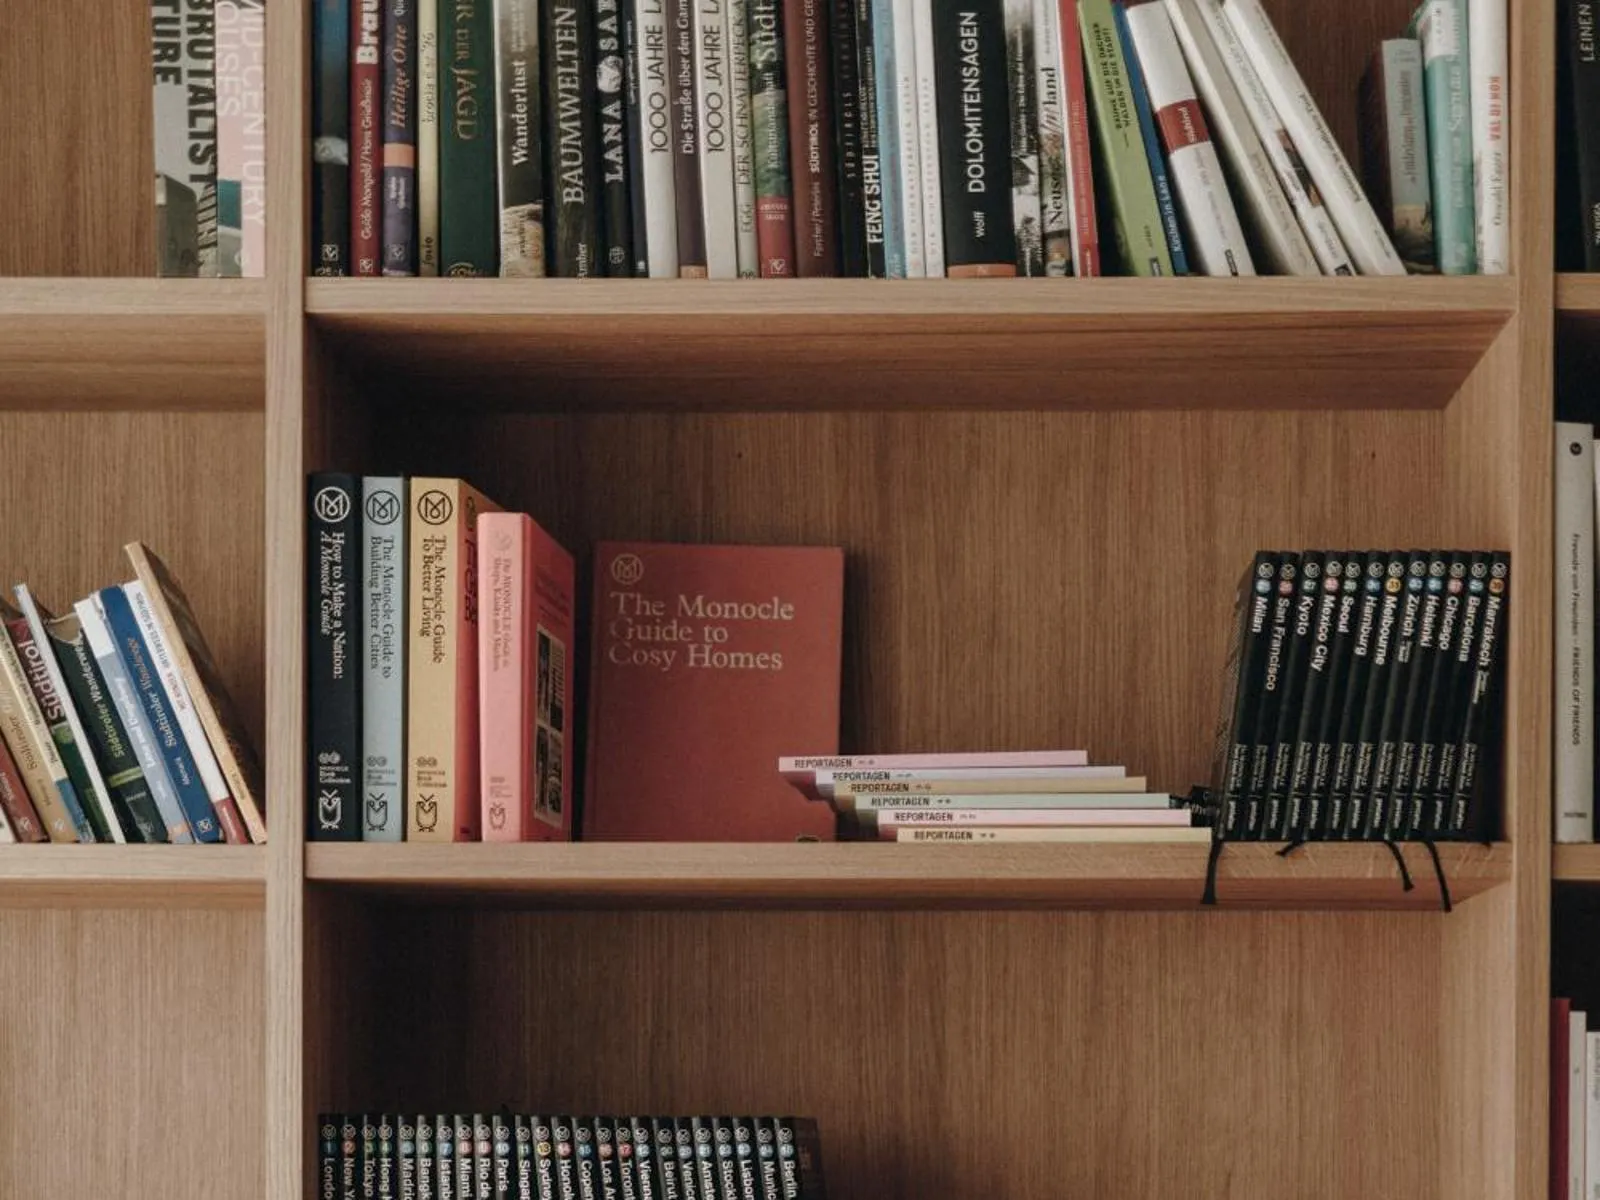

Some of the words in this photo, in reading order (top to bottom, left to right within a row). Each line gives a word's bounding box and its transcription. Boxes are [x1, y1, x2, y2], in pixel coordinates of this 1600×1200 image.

[676, 31, 690, 55] den
[1577, 3, 1595, 62] LEINEN
[646, 25, 666, 87] JAHRE
[676, 57, 692, 85] über
[703, 25, 723, 87] JAHRE
[390, 69, 410, 128] Heilige
[451, 66, 479, 140] JAGD
[511, 59, 528, 167] Wanderlust
[554, 6, 585, 205] BAUMWELTEN
[678, 87, 694, 130] Straße
[960, 12, 985, 193] DOLOMITENSAGEN
[602, 100, 624, 183] LANA
[648, 92, 669, 153] 1000
[706, 92, 726, 153] 1000
[682, 133, 695, 154] Die
[863, 154, 881, 197] SHUI
[865, 200, 883, 243] FENG
[332, 531, 345, 561] How
[369, 536, 382, 588] Building
[382, 536, 394, 561] The
[422, 536, 434, 551] To
[434, 535, 447, 562] The
[333, 564, 345, 578] to
[422, 555, 433, 592] Better
[332, 582, 346, 617] Make
[370, 592, 381, 629] Better
[382, 565, 394, 620] Monocle
[434, 566, 446, 620] Monocle
[610, 592, 665, 616] The
[677, 594, 795, 620] Monocle
[1278, 598, 1290, 624] San
[420, 596, 434, 638] Living
[610, 617, 693, 641] Guide
[703, 625, 729, 644] to
[1252, 596, 1268, 633] Milan
[1296, 596, 1313, 635] Kyoto
[1317, 595, 1336, 642] Mexico
[1337, 596, 1354, 633] Seoul
[1354, 596, 1377, 656] Hamburg
[1374, 595, 1398, 665] Melbourne
[1401, 594, 1420, 637] Zürich
[1420, 594, 1439, 647] Helsinki
[1439, 596, 1459, 650] Chicago
[1459, 596, 1480, 661] Barcelona
[1479, 596, 1500, 666] Marrakech
[332, 631, 347, 679] Nation:
[370, 633, 381, 670] Cities
[382, 623, 394, 662] Guide
[433, 624, 446, 663] Guide
[608, 642, 676, 672] Cosy
[687, 644, 784, 671] Homes
[1265, 626, 1286, 691] Francisco
[1311, 644, 1328, 672] City
[17, 638, 62, 721] Südtirol
[382, 665, 394, 678] to
[794, 758, 852, 768] REPORTAGEN
[832, 772, 890, 781] REPORTAGEN
[851, 783, 909, 793] REPORTAGEN
[871, 797, 930, 806] REPORTAGEN
[894, 812, 953, 822] REPORTAGEN
[914, 831, 973, 840] REPORTAGEN
[343, 1157, 355, 1187] New
[363, 1158, 375, 1198] Tokyo
[378, 1157, 391, 1191] Hong
[460, 1157, 472, 1198] Miami
[479, 1157, 490, 1179] Rio
[497, 1158, 509, 1192] Paris
[600, 1160, 613, 1184] Los
[663, 1161, 678, 1200] Beirut
[783, 1160, 797, 1199] Berlin
[480, 1182, 490, 1198] de
